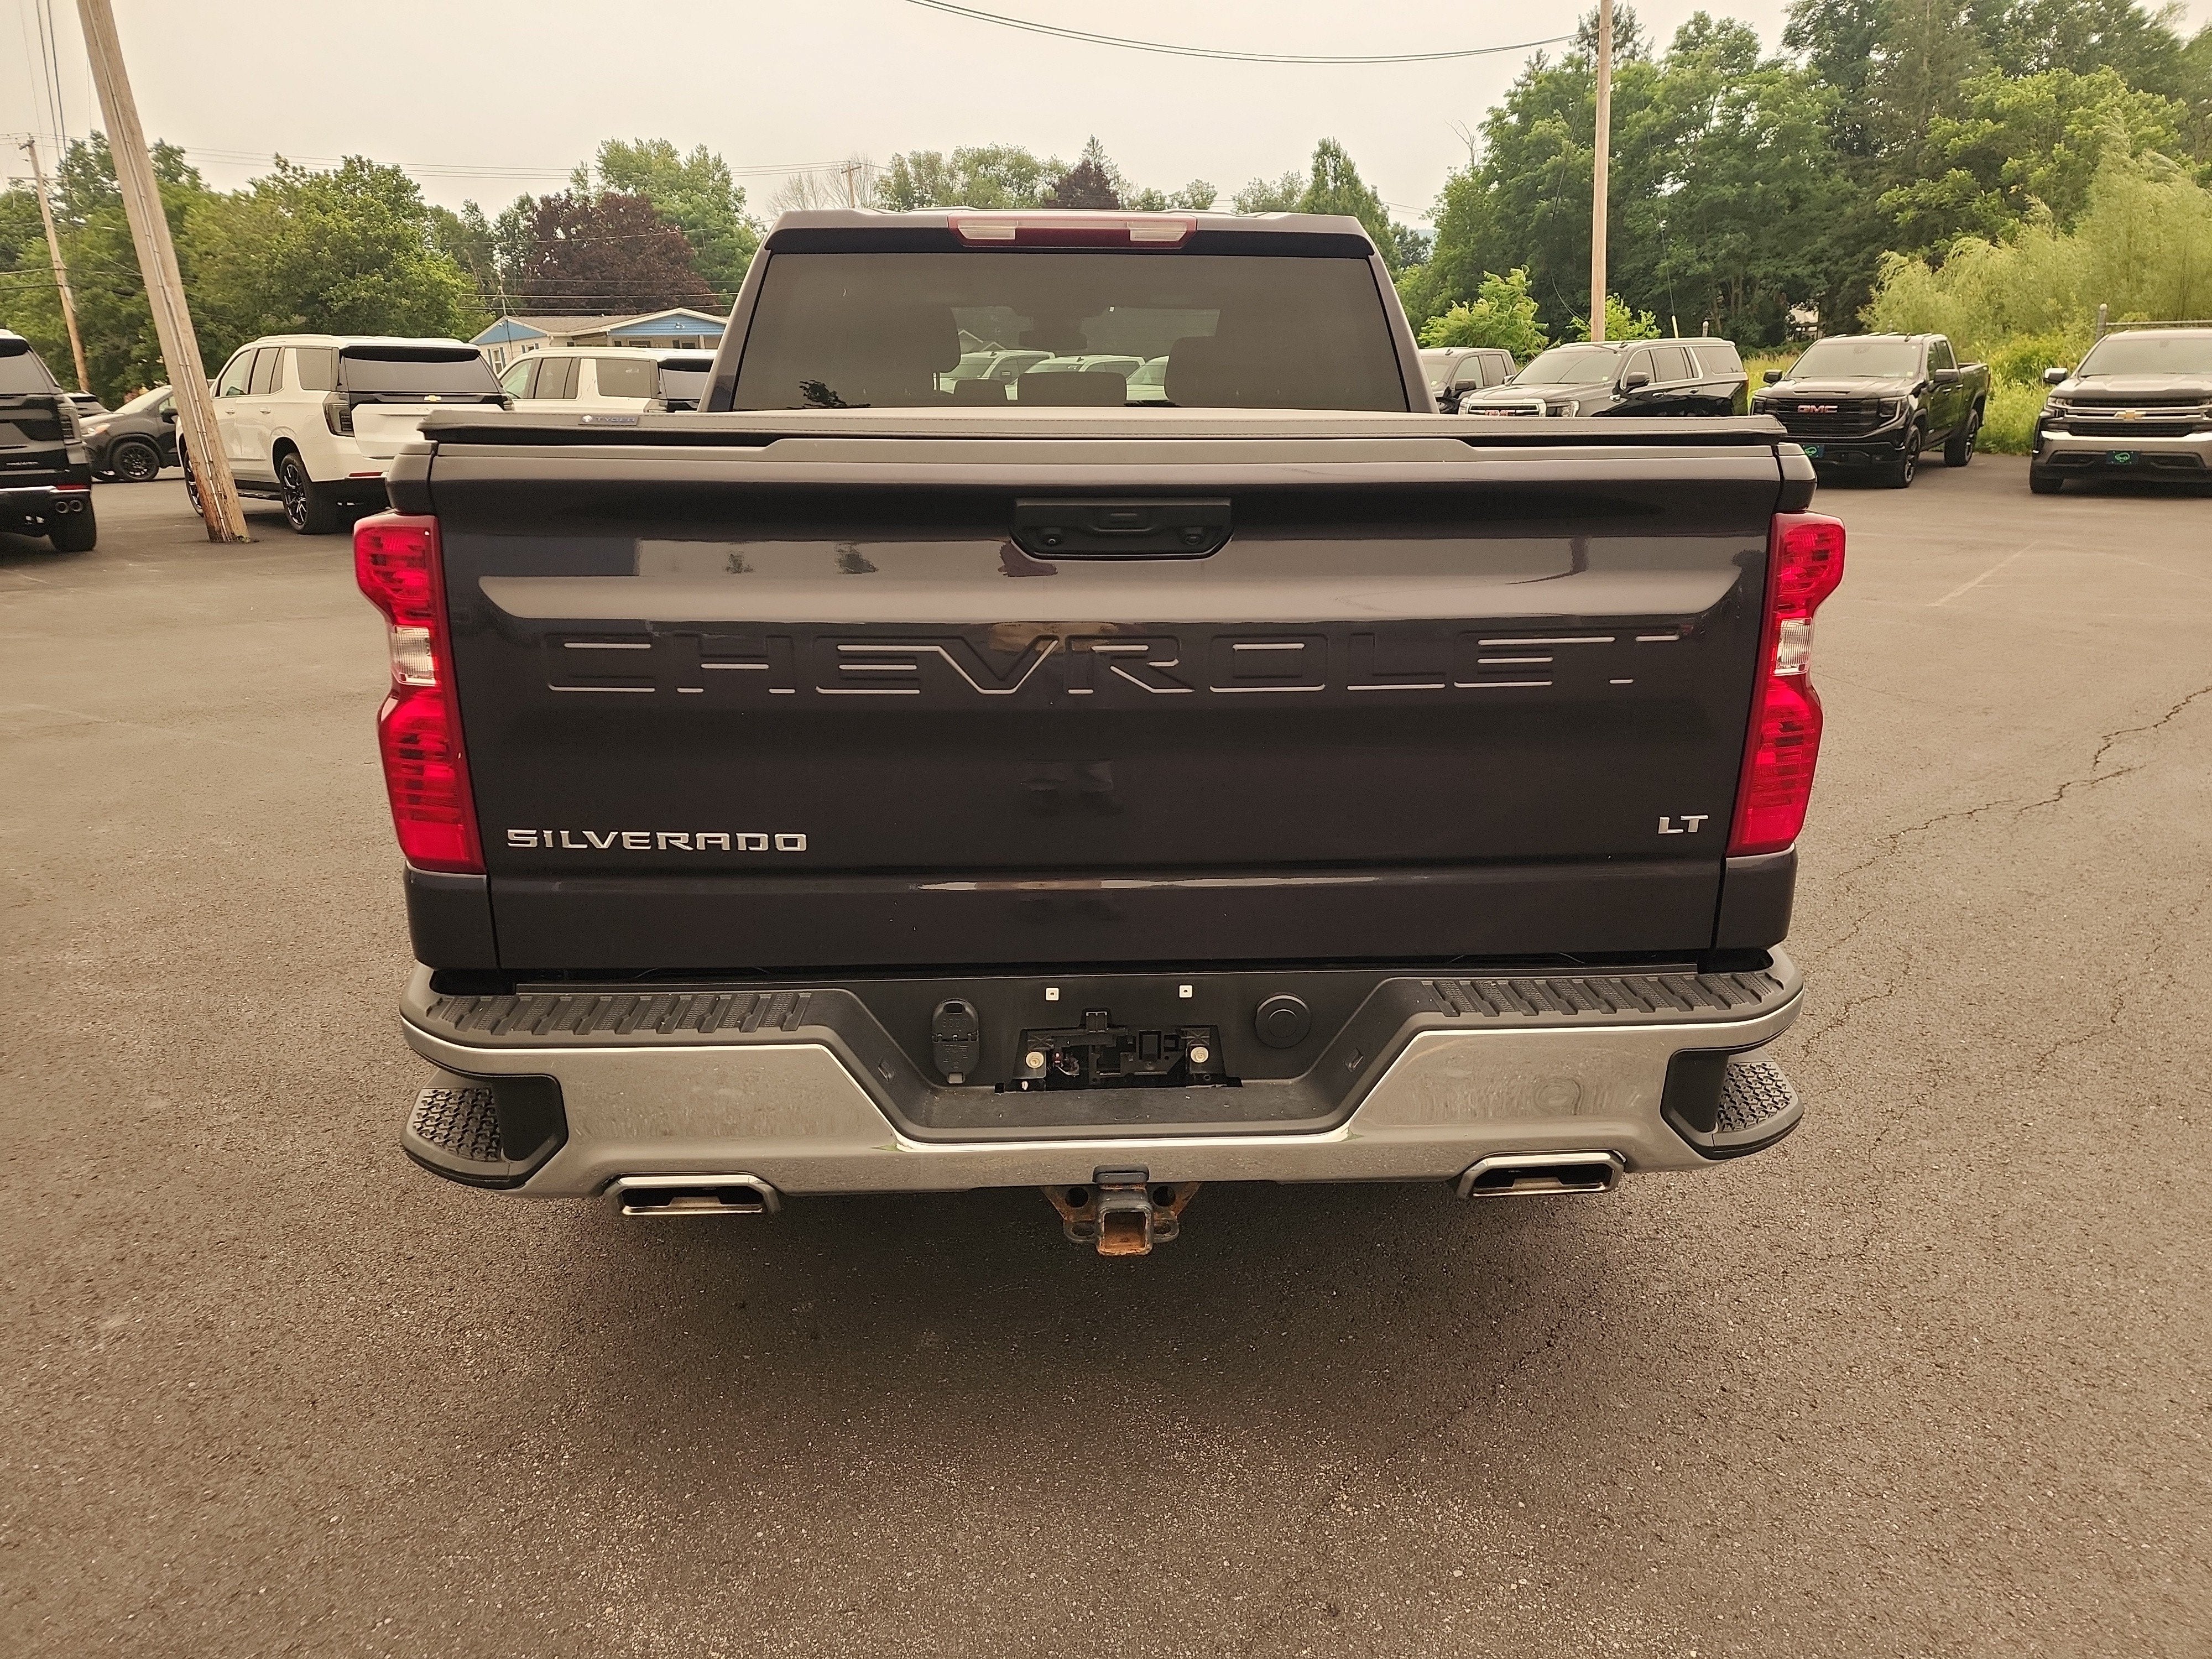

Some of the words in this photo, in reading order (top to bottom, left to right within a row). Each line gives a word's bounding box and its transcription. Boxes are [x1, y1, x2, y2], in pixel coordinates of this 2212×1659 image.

[1798, 405, 1838, 413] GMC
[543, 626, 1679, 694] CHEVROLET
[1658, 815, 1709, 834] LT
[507, 829, 807, 852] SILVERADO
